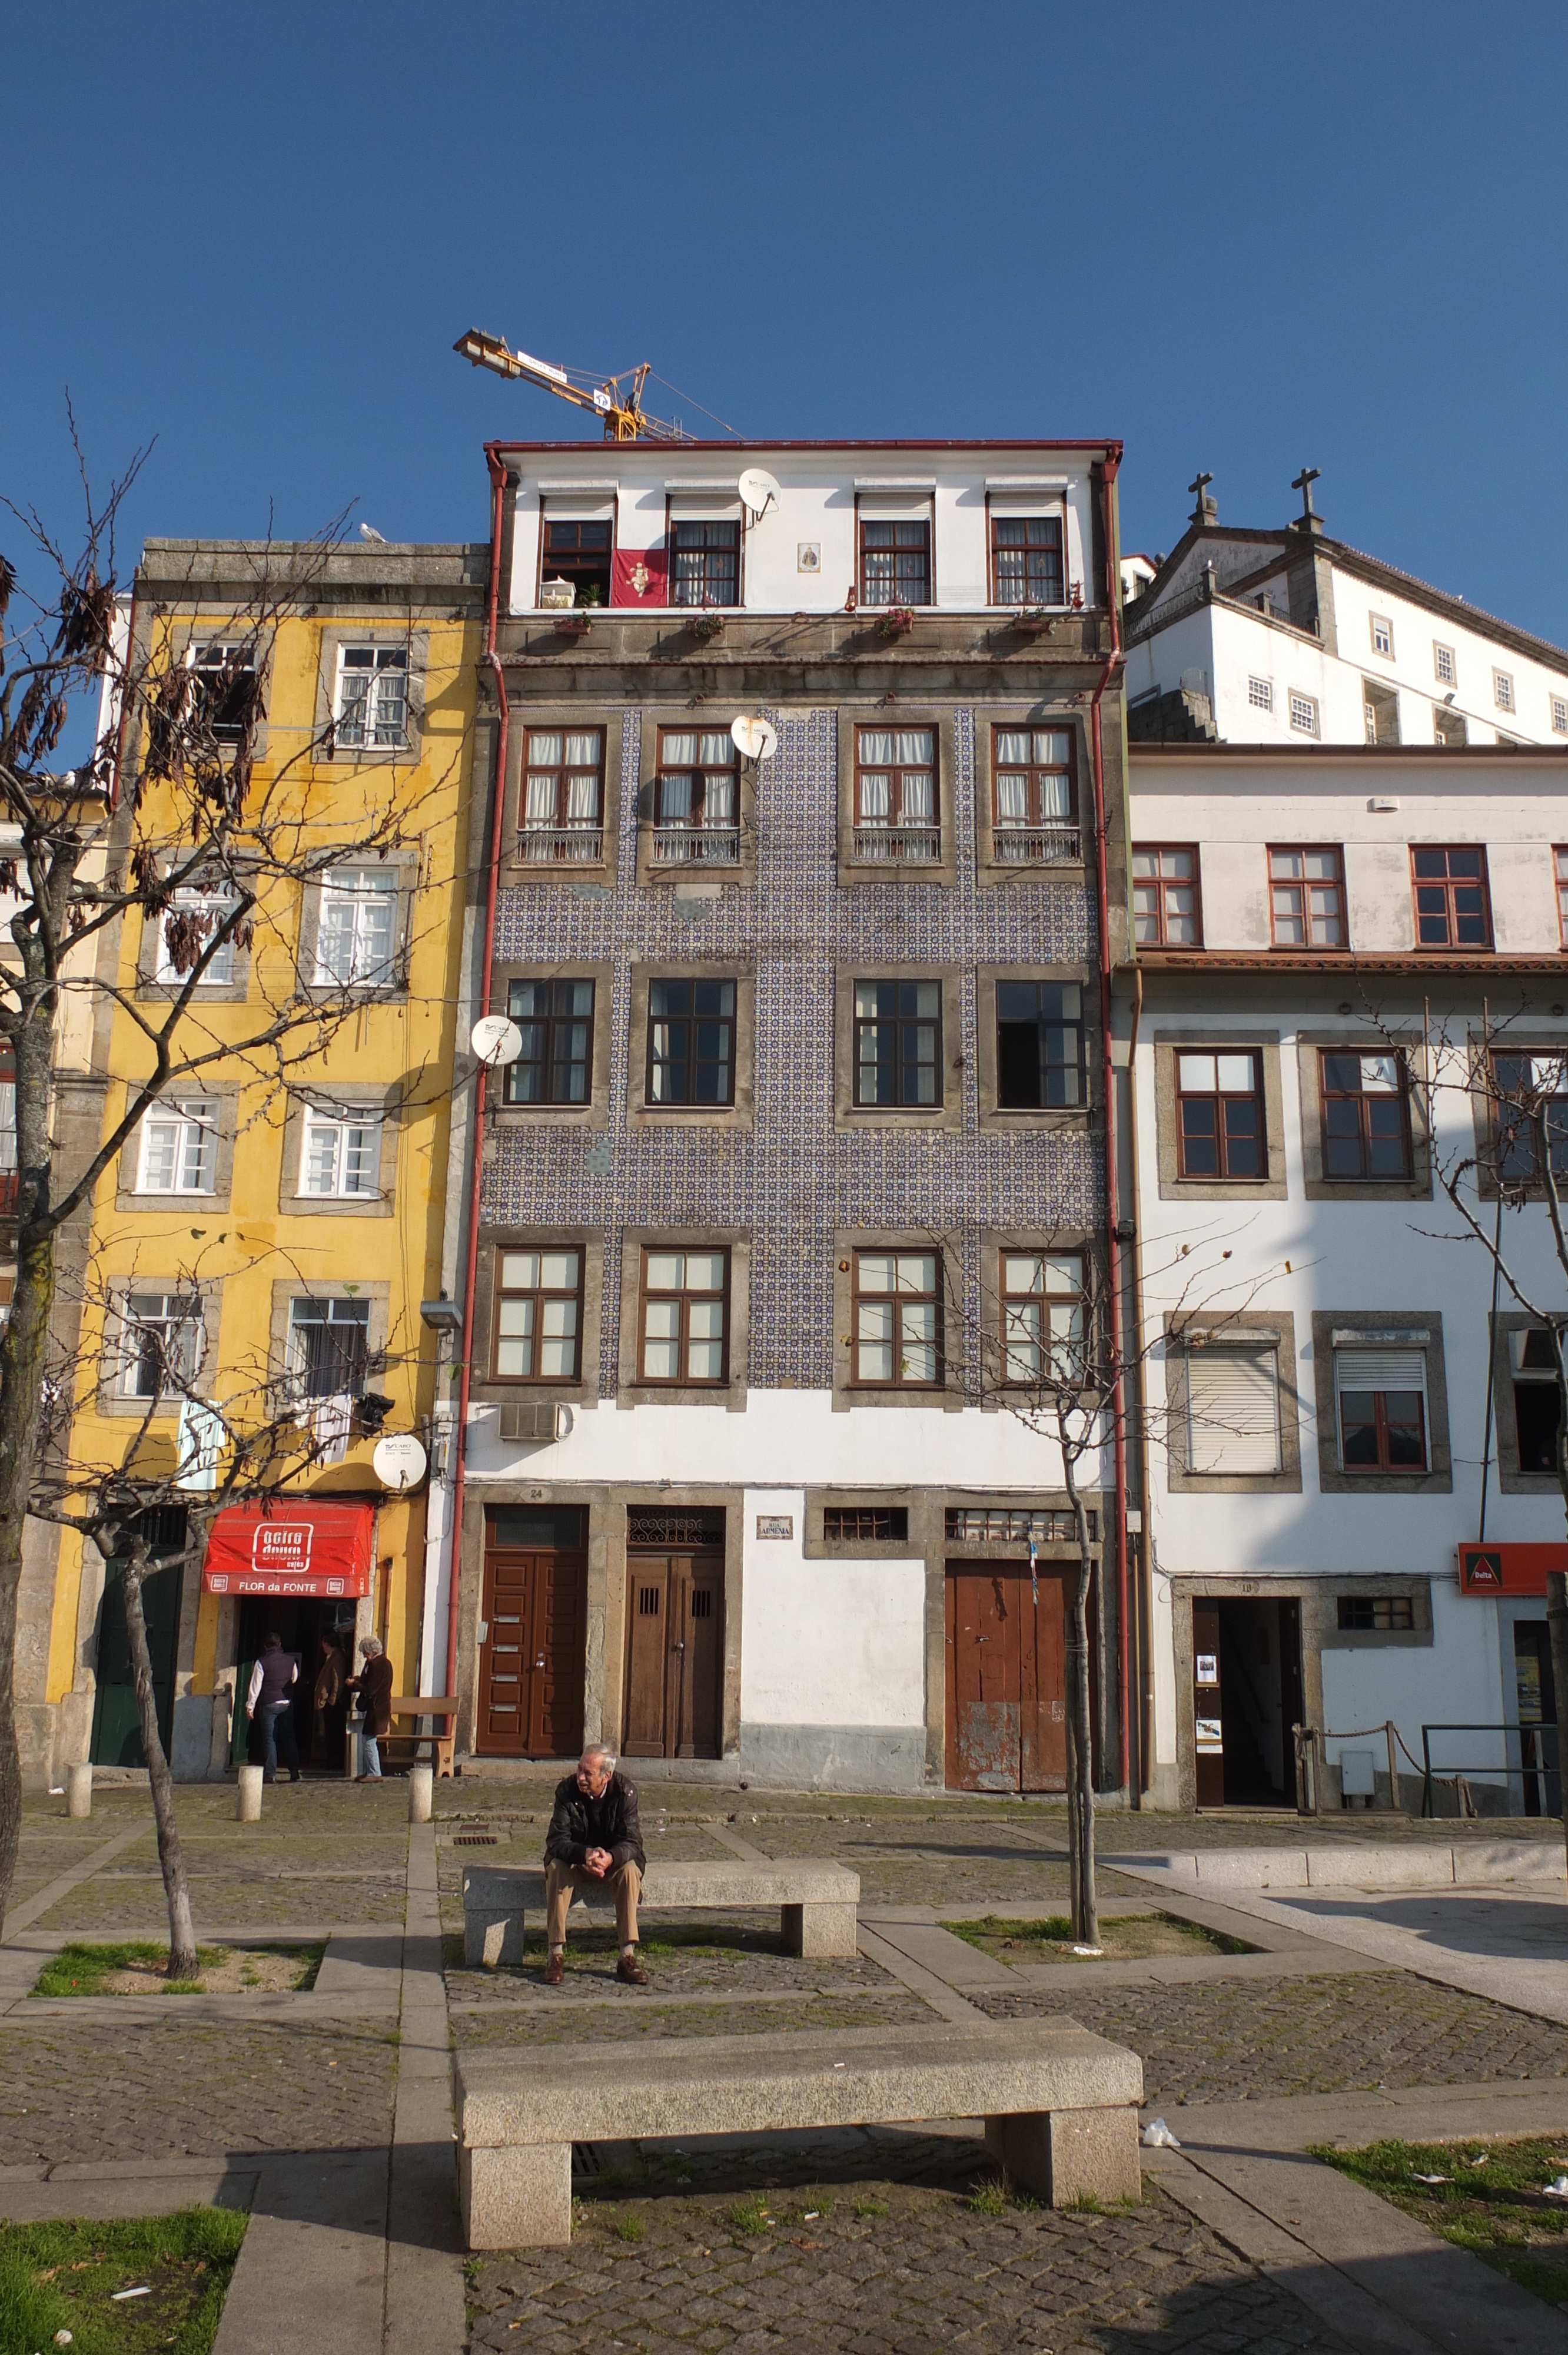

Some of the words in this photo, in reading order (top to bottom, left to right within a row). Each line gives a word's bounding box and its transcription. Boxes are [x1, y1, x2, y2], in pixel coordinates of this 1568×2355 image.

[530, 1489, 542, 1498] 24
[238, 1581, 265, 1591] FLOR
[267, 1583, 281, 1591] da
[283, 1583, 317, 1593] FONTE
